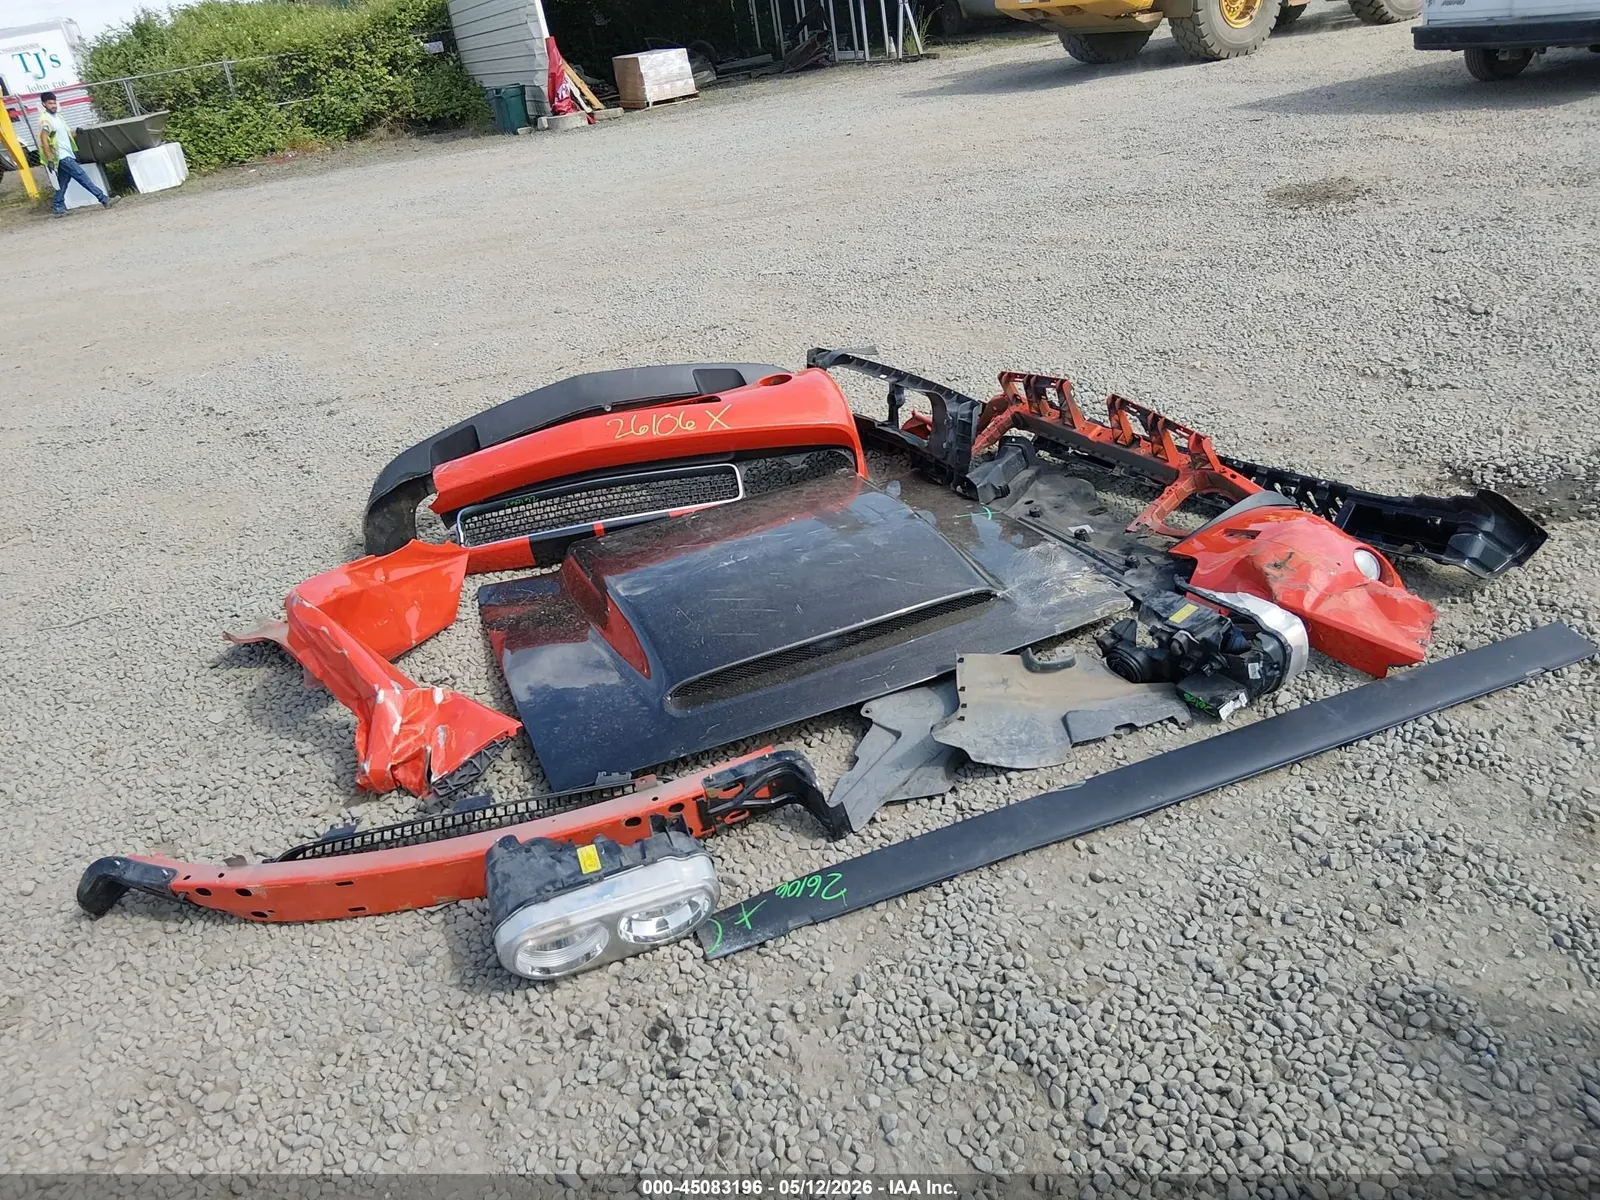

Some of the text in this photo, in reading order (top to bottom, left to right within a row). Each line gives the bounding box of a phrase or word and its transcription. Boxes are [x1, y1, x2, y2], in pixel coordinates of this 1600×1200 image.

[11, 47, 62, 80] TJ's
[27, 83, 51, 93] John
[606, 403, 732, 440] 26106 X
[775, 872, 848, 906] 26106
